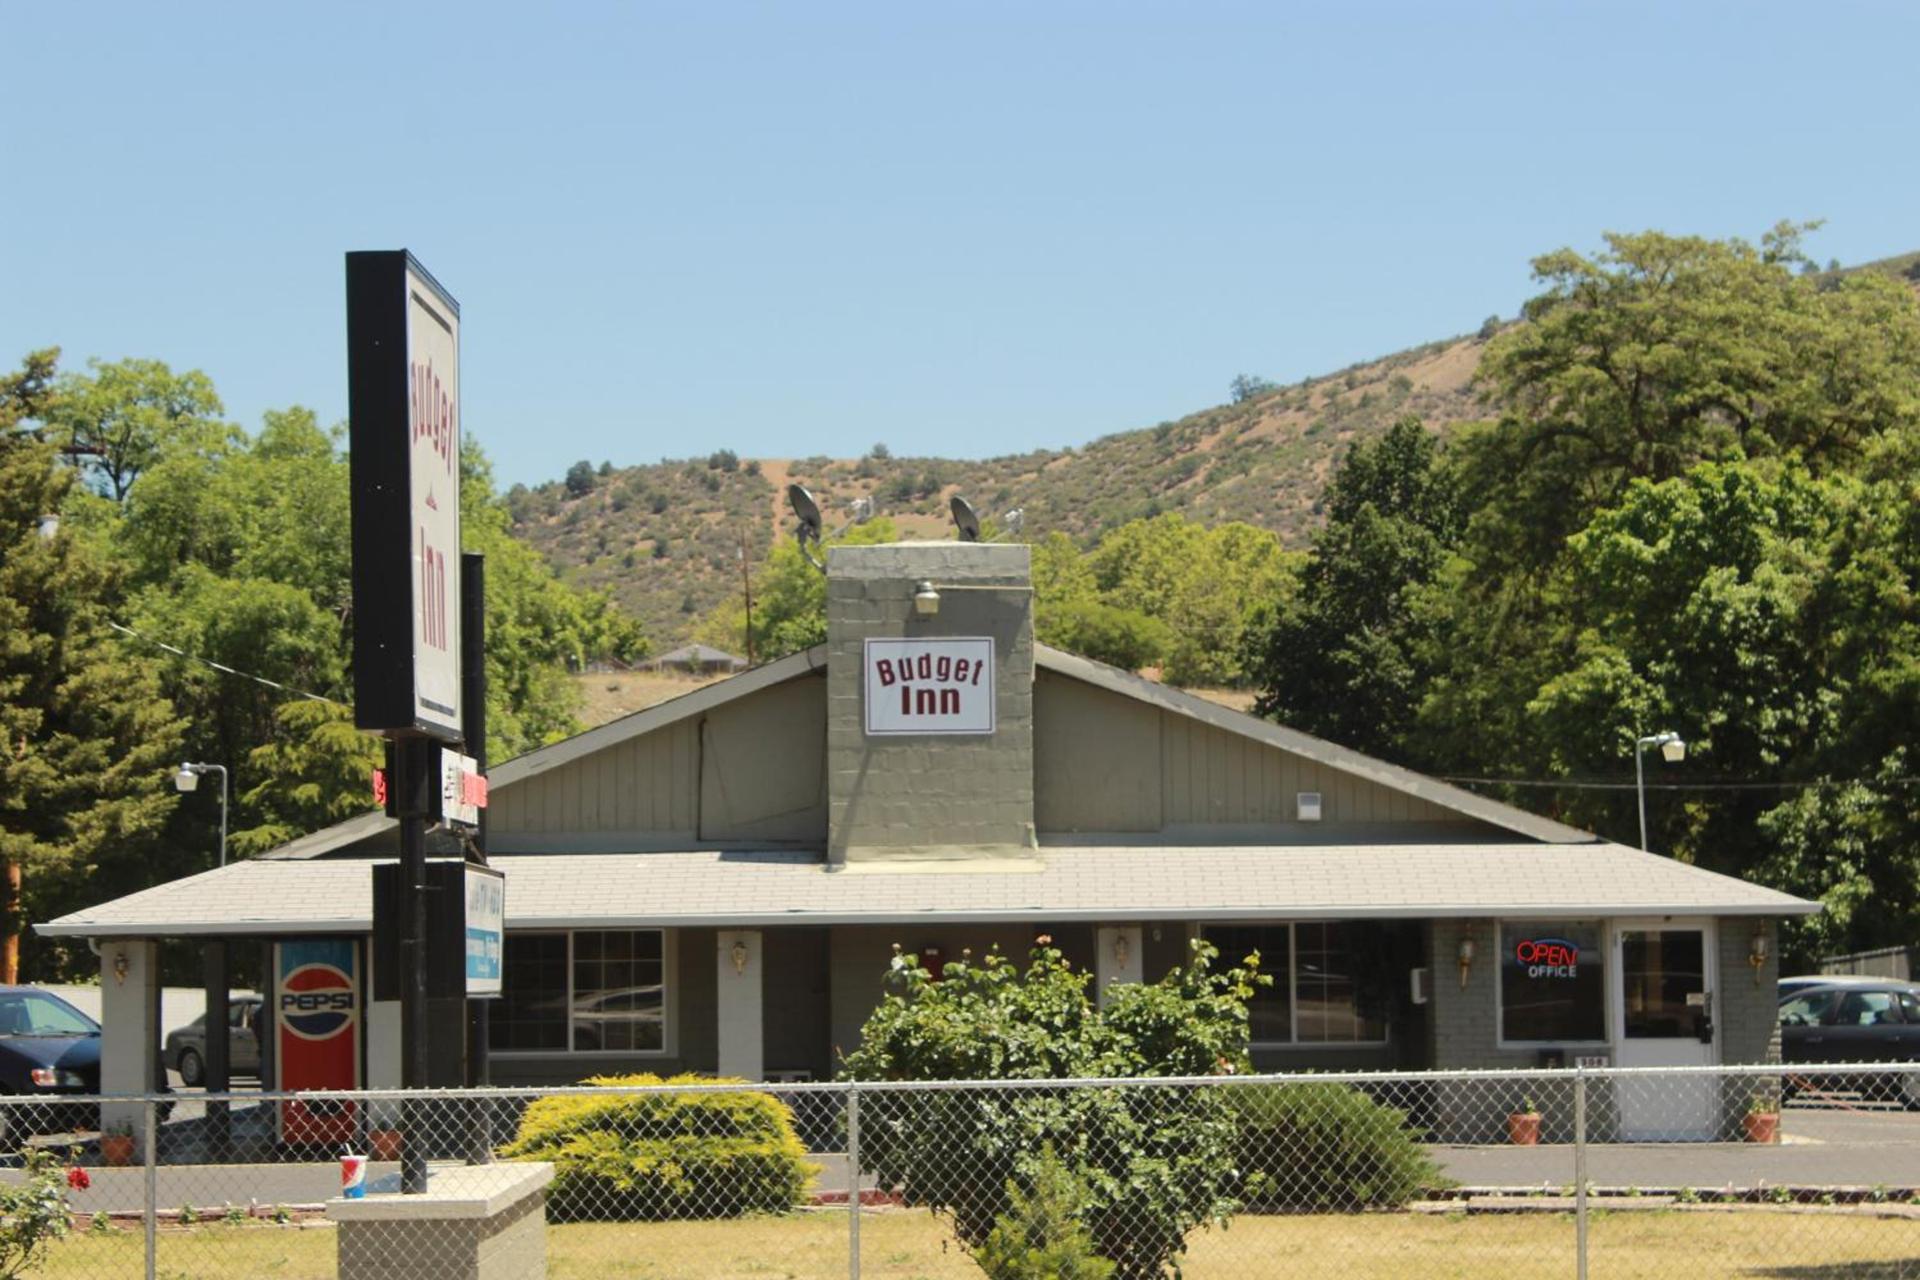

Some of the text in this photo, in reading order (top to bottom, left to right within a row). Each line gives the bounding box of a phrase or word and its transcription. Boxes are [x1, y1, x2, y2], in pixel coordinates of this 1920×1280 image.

[421, 526, 446, 652] Inn
[876, 653, 983, 686] Budget
[902, 686, 960, 715] Inn
[1517, 941, 1578, 966] OPEN
[1528, 965, 1577, 977] OFFICE
[281, 992, 354, 1010] PEPSI
